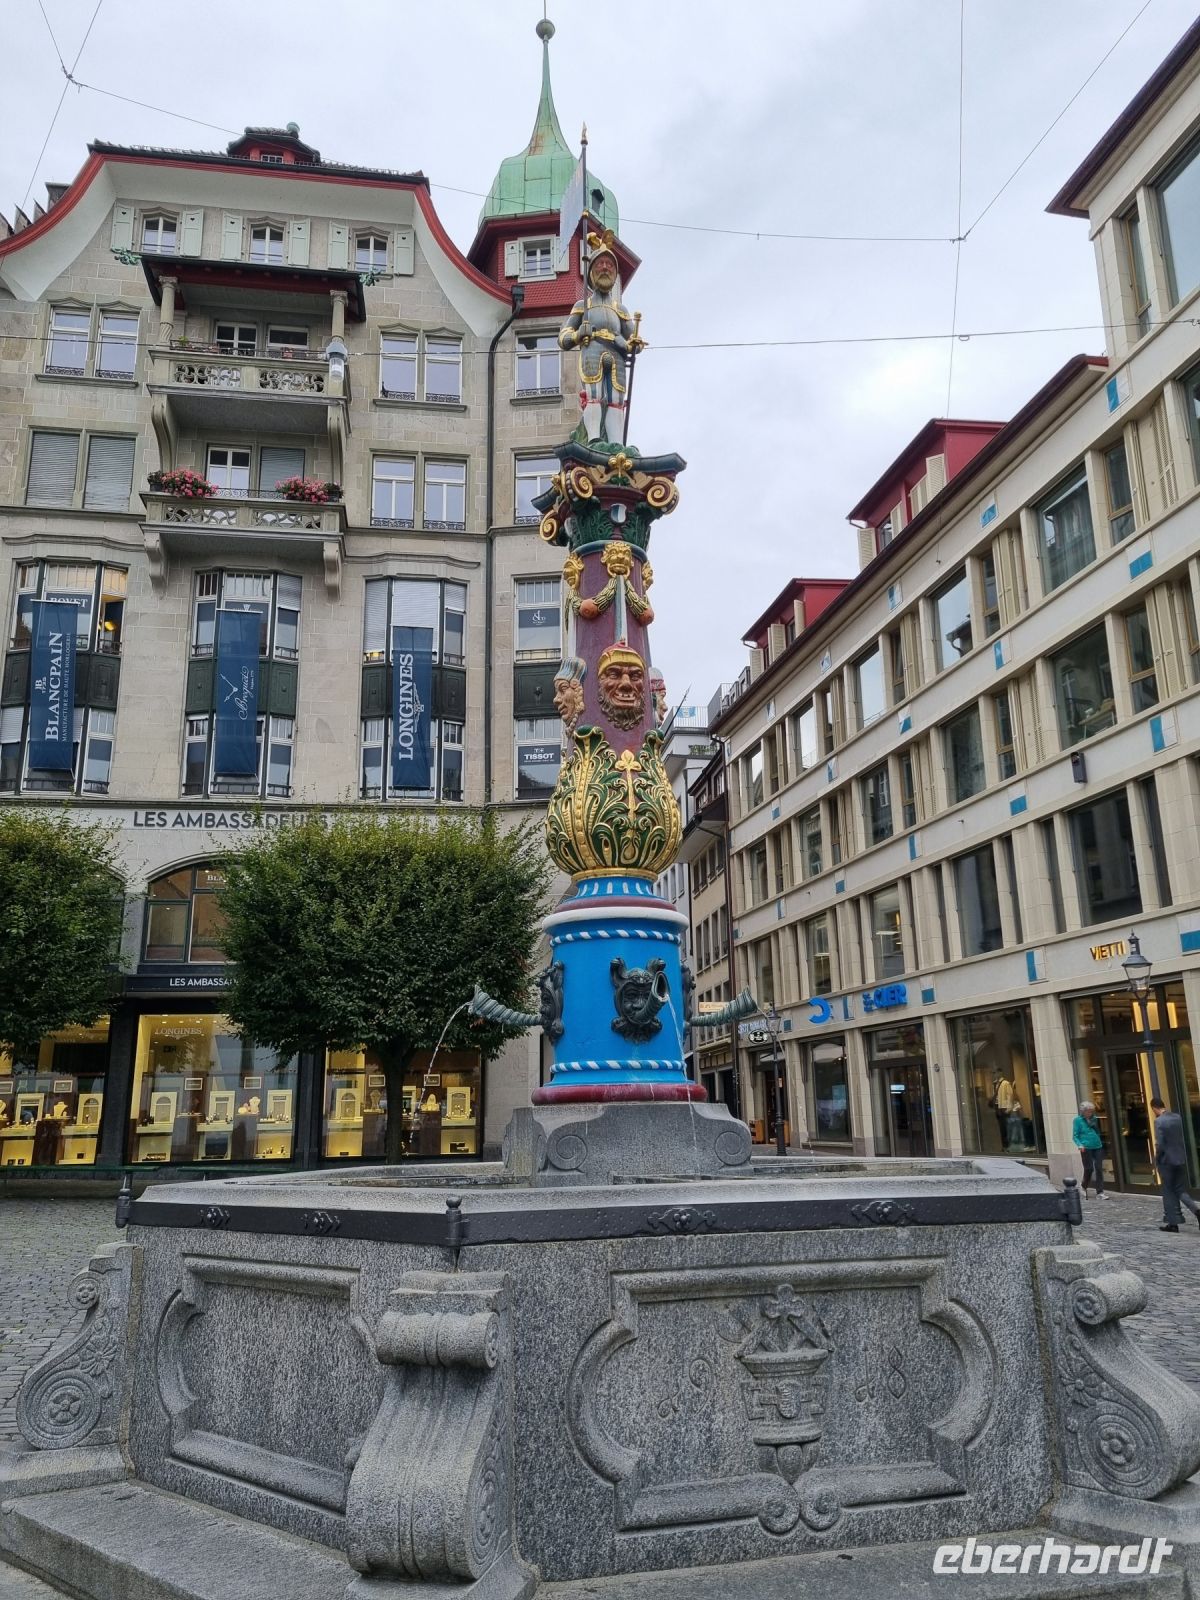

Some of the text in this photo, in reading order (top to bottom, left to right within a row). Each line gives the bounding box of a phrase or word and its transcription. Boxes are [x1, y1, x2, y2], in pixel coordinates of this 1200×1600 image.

[45, 631, 62, 742] BLANCPAIN
[398, 653, 414, 761] LONGINES
[133, 811, 328, 829] LES AMBASSADEUS
[169, 977, 186, 987] LES
[154, 1027, 202, 1036] LONGINES
